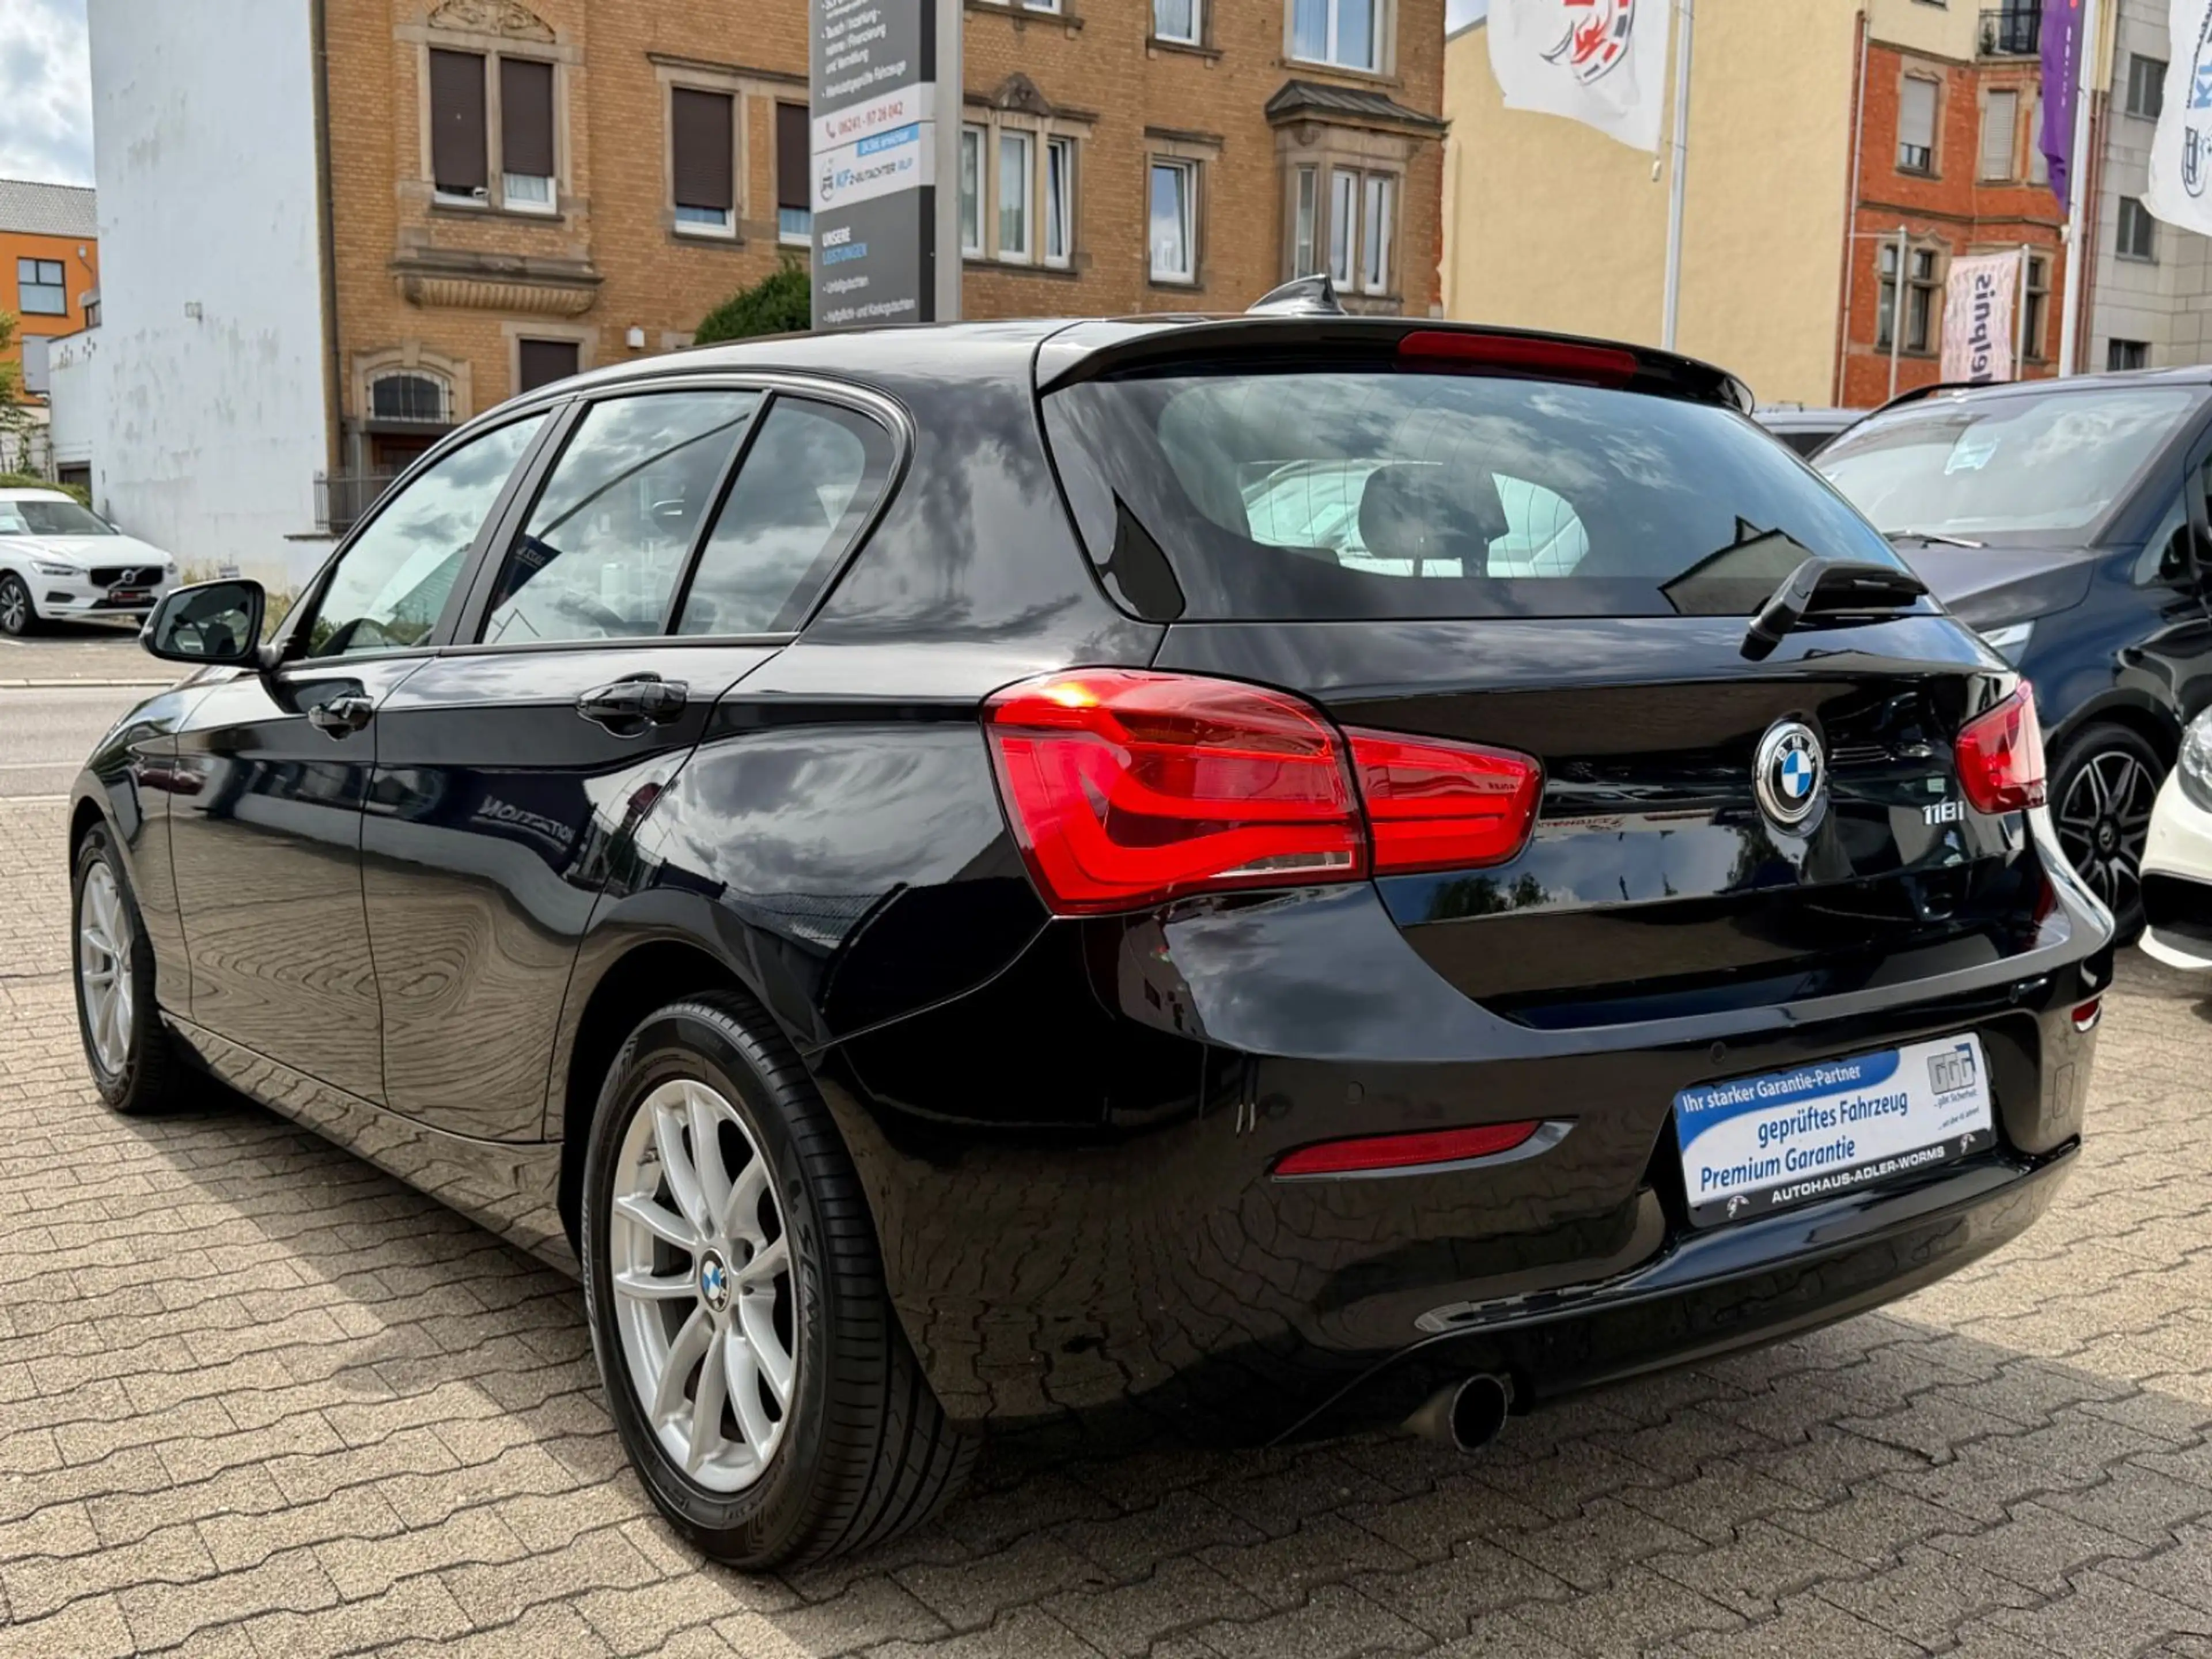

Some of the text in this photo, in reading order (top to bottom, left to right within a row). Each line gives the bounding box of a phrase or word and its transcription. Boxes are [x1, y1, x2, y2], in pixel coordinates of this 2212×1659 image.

[823, 226, 850, 247] UNSERE
[1683, 1064, 1862, 1113] Ihr starker Garantie-Partner
[1758, 1092, 1907, 1148] geprüftes Fahrzeug
[1700, 1138, 1855, 1192] Premium Garantie
